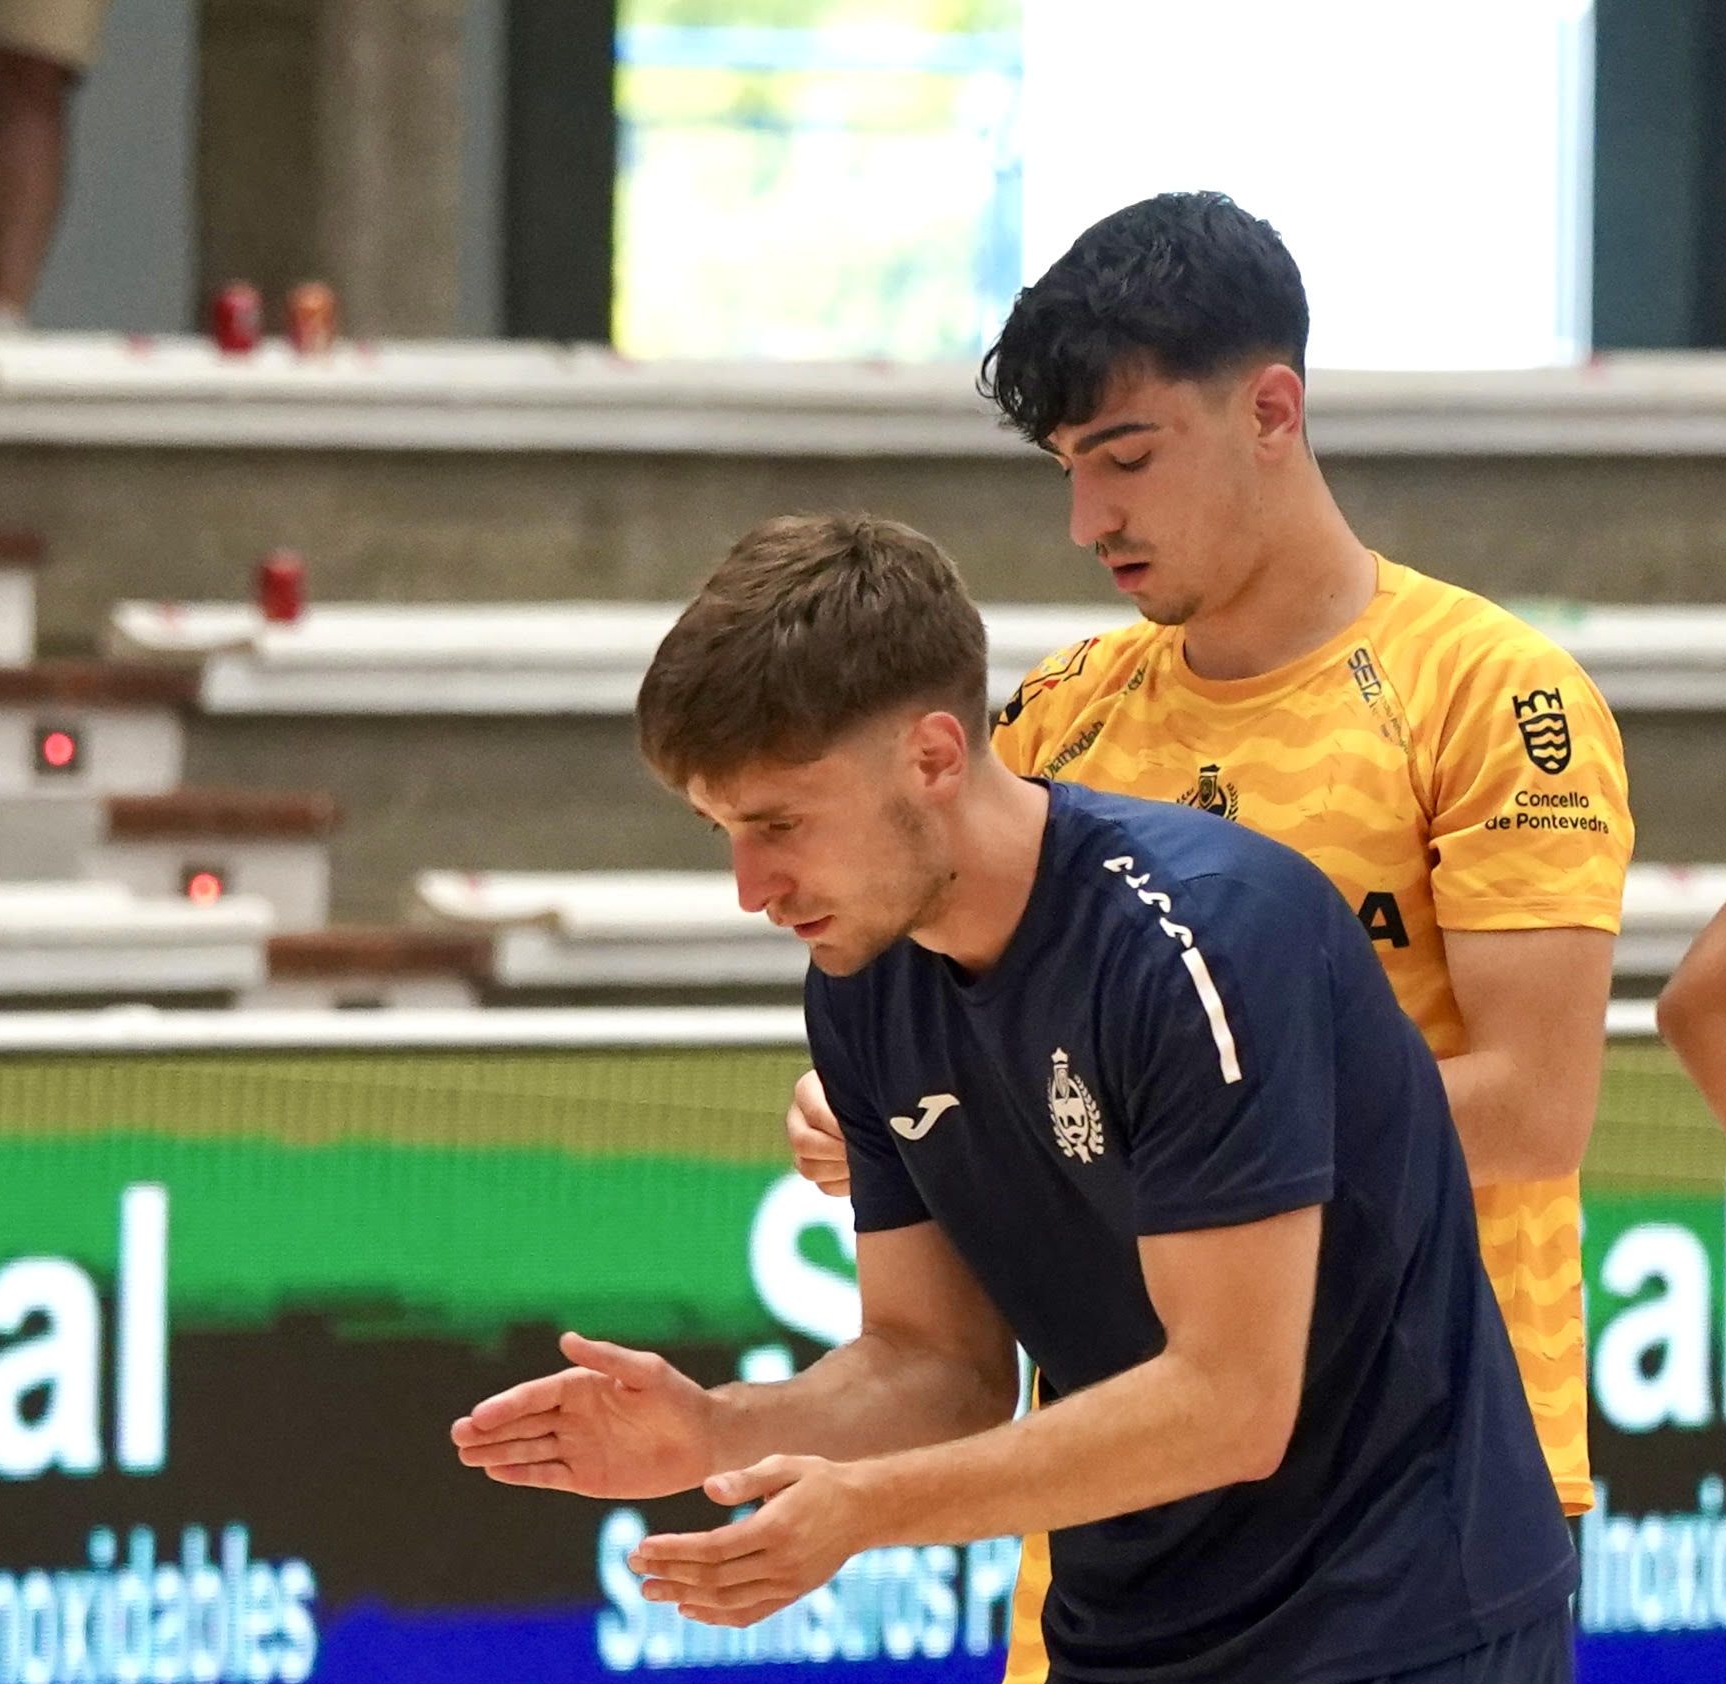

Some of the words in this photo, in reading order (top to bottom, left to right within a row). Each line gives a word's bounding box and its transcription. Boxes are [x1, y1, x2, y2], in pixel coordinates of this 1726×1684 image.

[1515, 790, 1590, 808] Concello
[1485, 816, 1511, 830] de
[1516, 813, 1609, 834] Pontevedra
